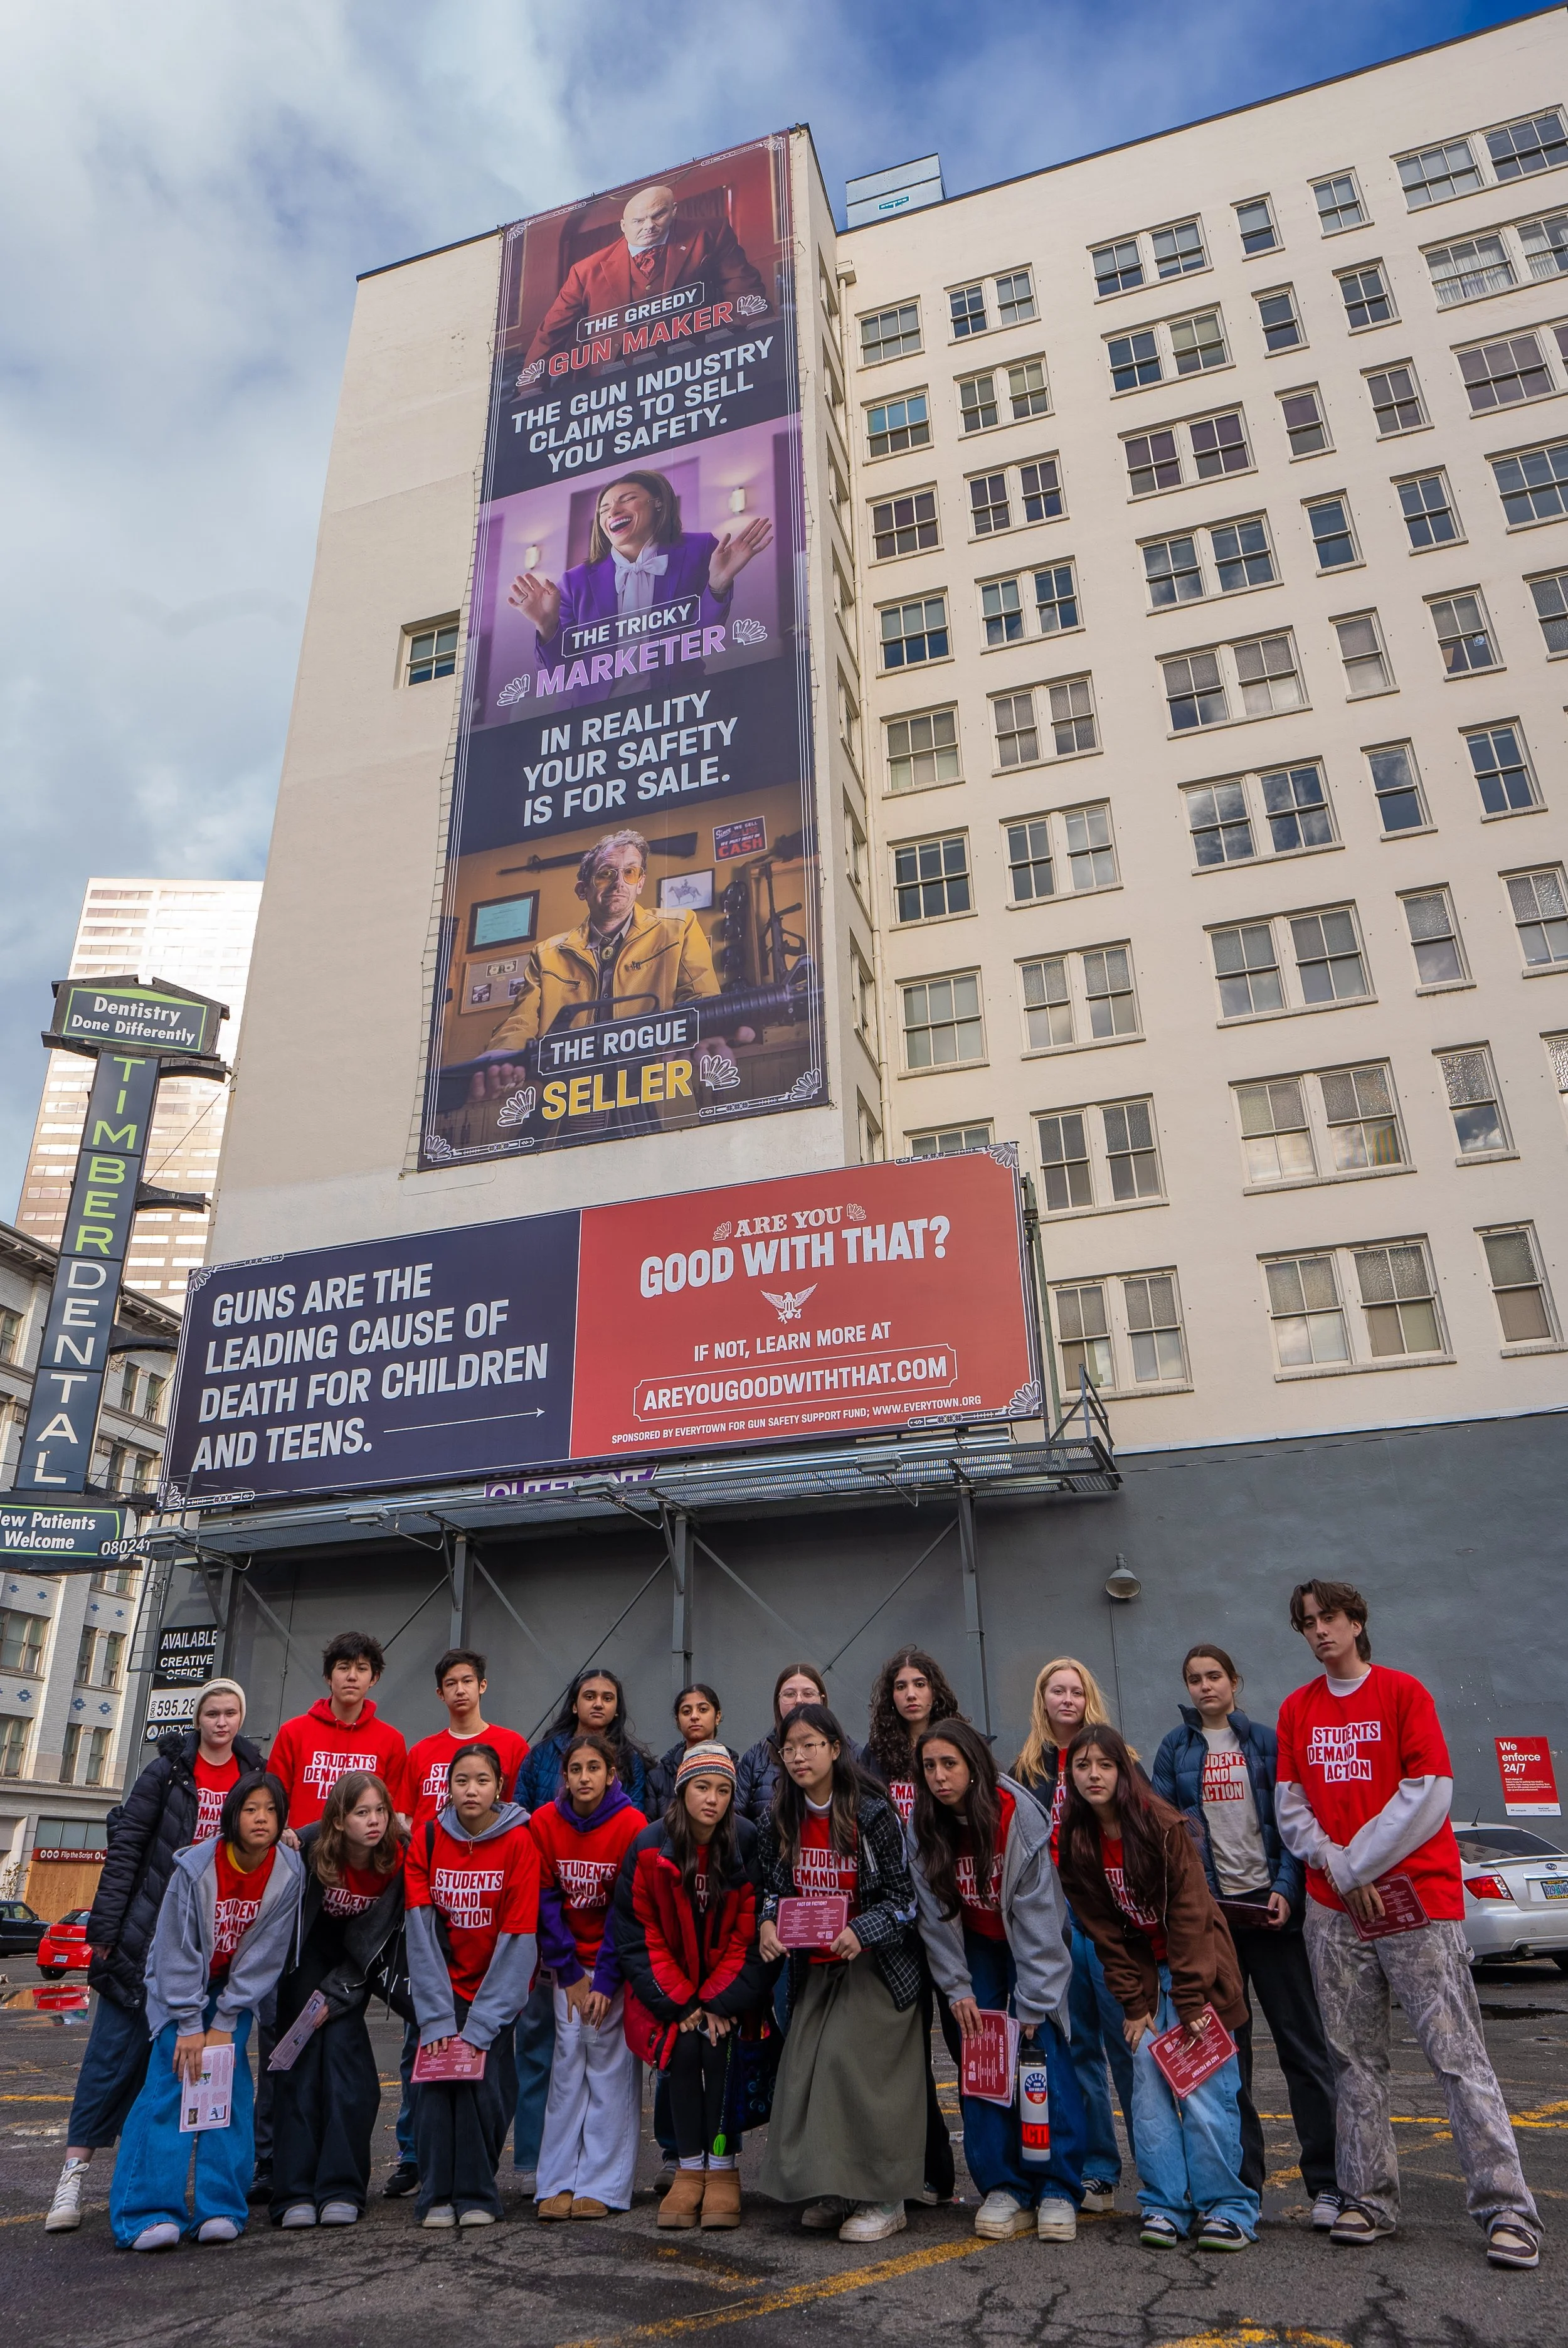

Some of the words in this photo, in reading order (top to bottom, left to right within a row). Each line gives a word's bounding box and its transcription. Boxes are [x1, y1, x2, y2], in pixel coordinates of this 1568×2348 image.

[585, 314, 617, 335] THE
[625, 289, 697, 323] GREEDY
[548, 339, 611, 377] GUN
[623, 302, 733, 354] MAKER
[512, 401, 561, 433] THE
[569, 381, 627, 416] GUN
[637, 336, 773, 396] INDUSTRY
[529, 405, 633, 454] CLAIMS
[640, 393, 674, 424] TO
[684, 372, 753, 407] SELL
[548, 440, 603, 474] YOU
[614, 404, 727, 454] SAFETY.
[571, 625, 610, 649] THE
[615, 603, 692, 638] TRICKY
[536, 625, 726, 698] MARKETER
[541, 725, 570, 756] IN
[581, 689, 711, 746] REALITY
[523, 752, 607, 792] YOUR
[618, 717, 738, 770] SAFETY
[523, 795, 553, 827] IS
[563, 778, 626, 817] FOR
[637, 757, 730, 800] SALE.
[718, 837, 763, 857] CASH
[93, 996, 181, 1026] Dentistry
[72, 1014, 109, 1033] Done
[115, 1021, 195, 1046] Differently
[550, 1036, 593, 1065] THE
[603, 1018, 687, 1055] ROGUE
[542, 1061, 692, 1120] SELLER
[75, 1056, 146, 1255] TIMBER
[734, 1216, 787, 1239] ARE
[792, 1207, 844, 1230] YOU
[640, 1246, 734, 1298] GOOD
[743, 1231, 835, 1277] WITH
[841, 1215, 951, 1263] THAT?
[212, 1283, 295, 1327] GUNS
[302, 1273, 366, 1315] ARE
[373, 1263, 433, 1304] THE
[204, 1325, 337, 1374] LEADING
[348, 1307, 455, 1355] CAUSE
[464, 1299, 509, 1339] OF
[694, 1345, 709, 1362] IF
[714, 1339, 750, 1360] NOT,
[756, 1332, 811, 1354] LEARN
[817, 1326, 866, 1347] MORE
[870, 1322, 891, 1341] AT
[34, 1262, 107, 1484] DENTAL
[198, 1378, 298, 1423] DEATH
[307, 1368, 371, 1409] FOR
[381, 1342, 548, 1400] CHILDREN
[643, 1356, 947, 1411] AREYOUGOODWITHTHAT.COM
[612, 1430, 661, 1443] SPONSORED
[662, 1428, 674, 1438] BY
[675, 1423, 726, 1437] EVERYTOWN
[728, 1420, 745, 1431] FOR
[748, 1418, 766, 1429] GUN
[768, 1415, 800, 1428] SAFETY
[801, 1411, 841, 1425] SUPPORT
[842, 1407, 870, 1420] FUND;
[872, 1396, 982, 1416] WWW.EVERYTOWN.ORG
[191, 1431, 257, 1472] AND
[266, 1417, 373, 1462] TEENS.
[31, 1512, 97, 1531] Patients
[5, 1531, 75, 1549] Welcome
[161, 1630, 217, 1650] AVAILABLE
[161, 1654, 213, 1667] CREATIVE
[157, 1698, 195, 1717] 595.28
[1314, 1723, 1379, 1744] STUDENTS
[1499, 1741, 1517, 1750] We
[314, 1753, 375, 1770] STUDENTS
[1308, 1743, 1355, 1763] DEMAND
[1502, 1753, 1540, 1761] enforce
[1503, 1763, 1525, 1774] 24/7
[305, 1767, 344, 1783] DEMA
[1204, 1768, 1229, 1782] AND
[1327, 1760, 1370, 1780] ACTON
[424, 1779, 448, 1794] DEM
[61, 1851, 70, 1859] Flip
[800, 1849, 857, 1869] TUDENTS
[437, 1871, 502, 1889] STUDENTS
[794, 1869, 837, 1888] EMAND
[327, 1889, 377, 1909] TUDENT
[432, 1888, 479, 1908] DEMAND
[451, 1910, 490, 1927] CTION
